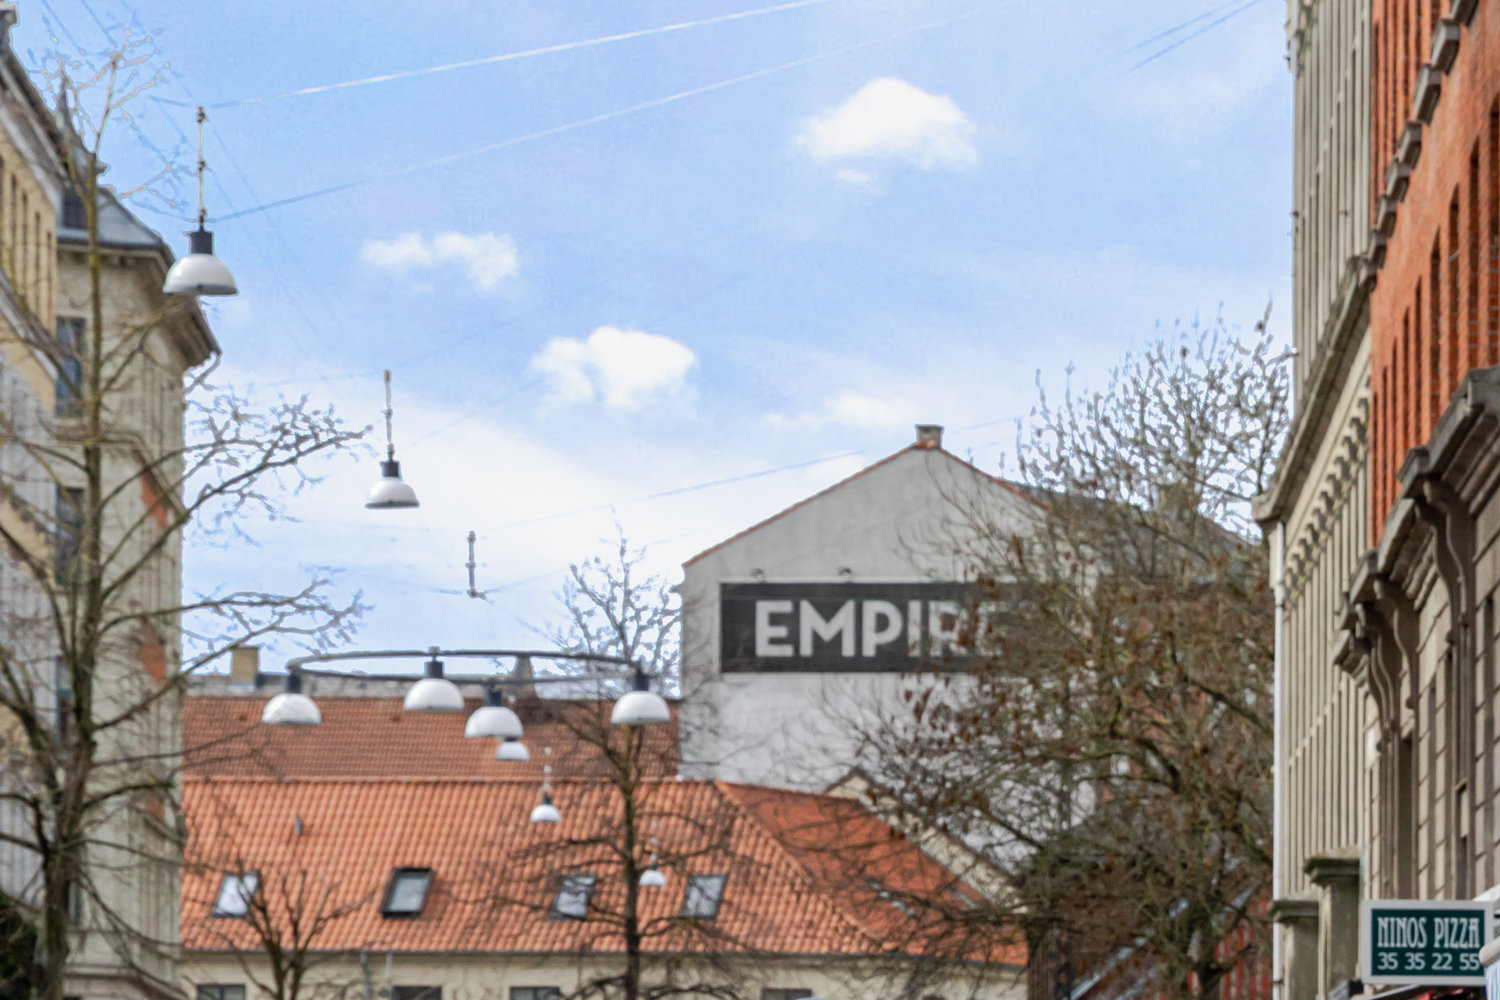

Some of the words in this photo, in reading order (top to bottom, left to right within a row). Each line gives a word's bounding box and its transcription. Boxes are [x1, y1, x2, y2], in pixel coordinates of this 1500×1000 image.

[1377, 916, 1427, 949] NINOS
[1433, 917, 1480, 949] PIZZA
[1377, 952, 1399, 970] 35
[1404, 952, 1426, 970] 35
[1431, 953, 1453, 970] 22
[1459, 953, 1480, 971] 55
